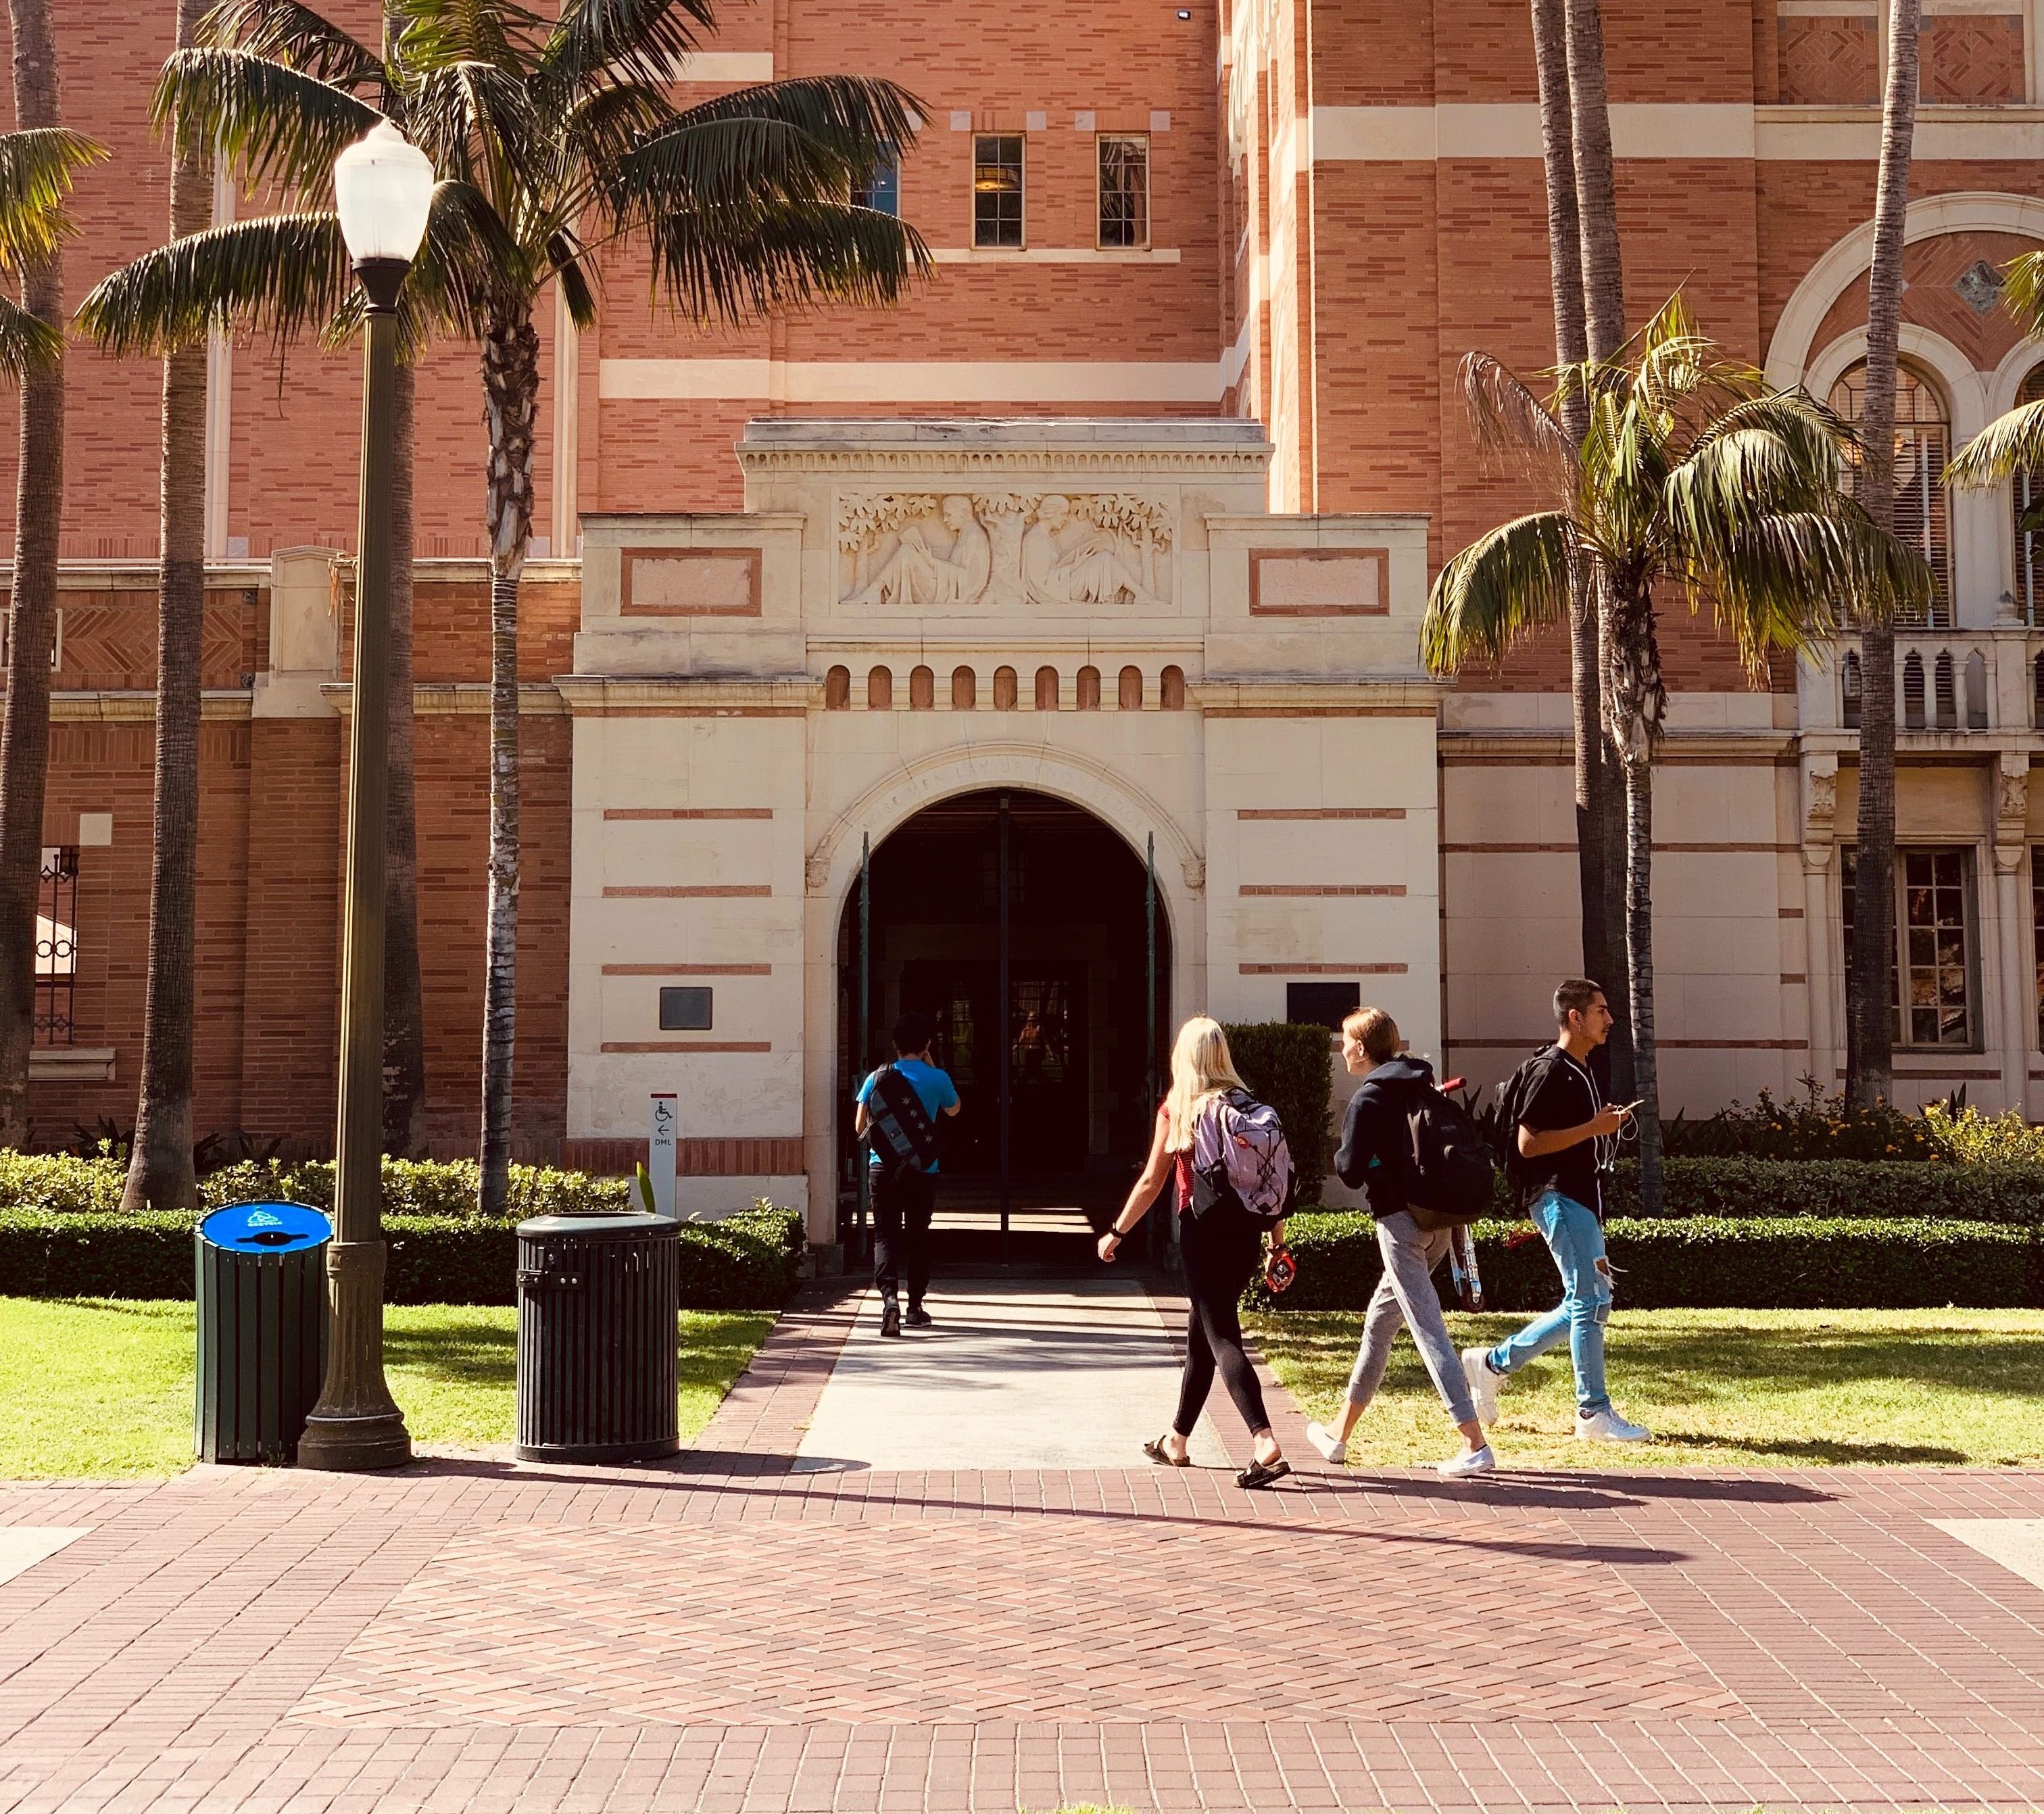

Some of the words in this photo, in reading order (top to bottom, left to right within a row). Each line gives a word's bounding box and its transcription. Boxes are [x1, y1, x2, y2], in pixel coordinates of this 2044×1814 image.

[861, 795, 902, 832] WISE
[954, 761, 989, 779] LAY
[1000, 761, 1022, 774] UP
